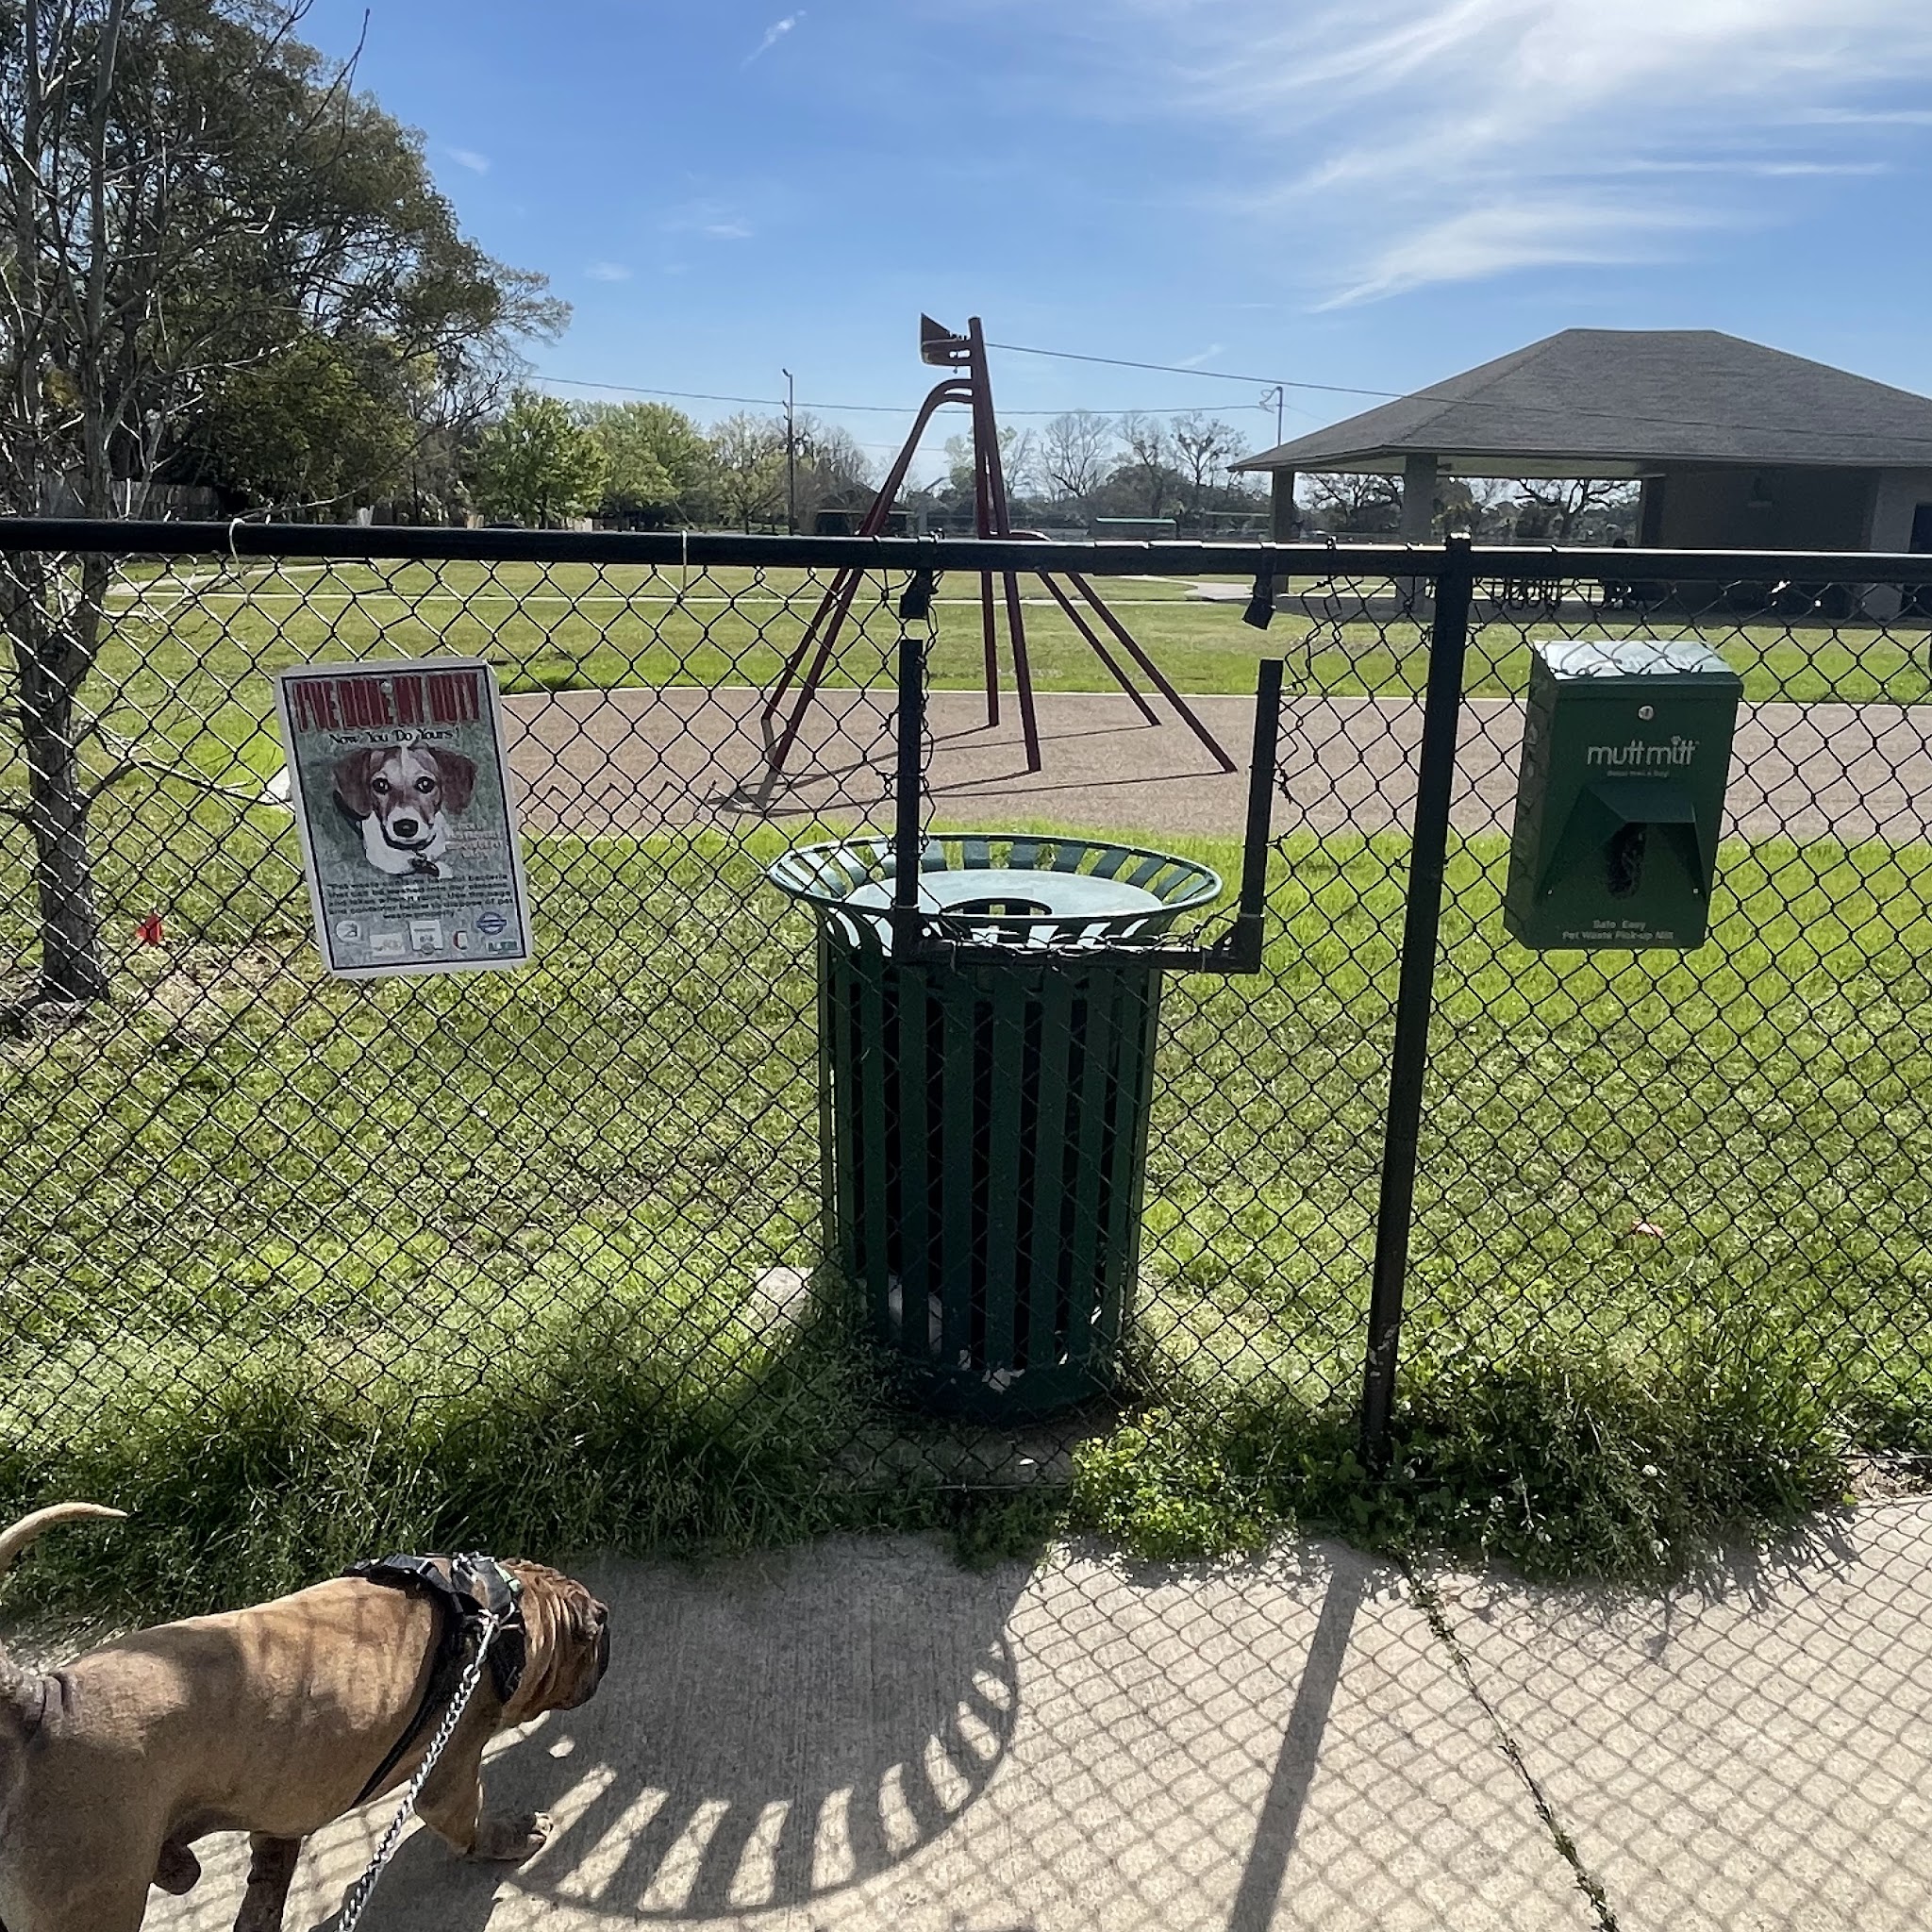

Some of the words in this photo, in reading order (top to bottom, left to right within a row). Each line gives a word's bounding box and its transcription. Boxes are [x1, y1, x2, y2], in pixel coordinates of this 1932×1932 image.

[392, 675, 425, 726] MY
[427, 672, 480, 724] DUTY
[329, 732, 358, 744] Now
[366, 731, 389, 743] You
[394, 729, 413, 741] Do
